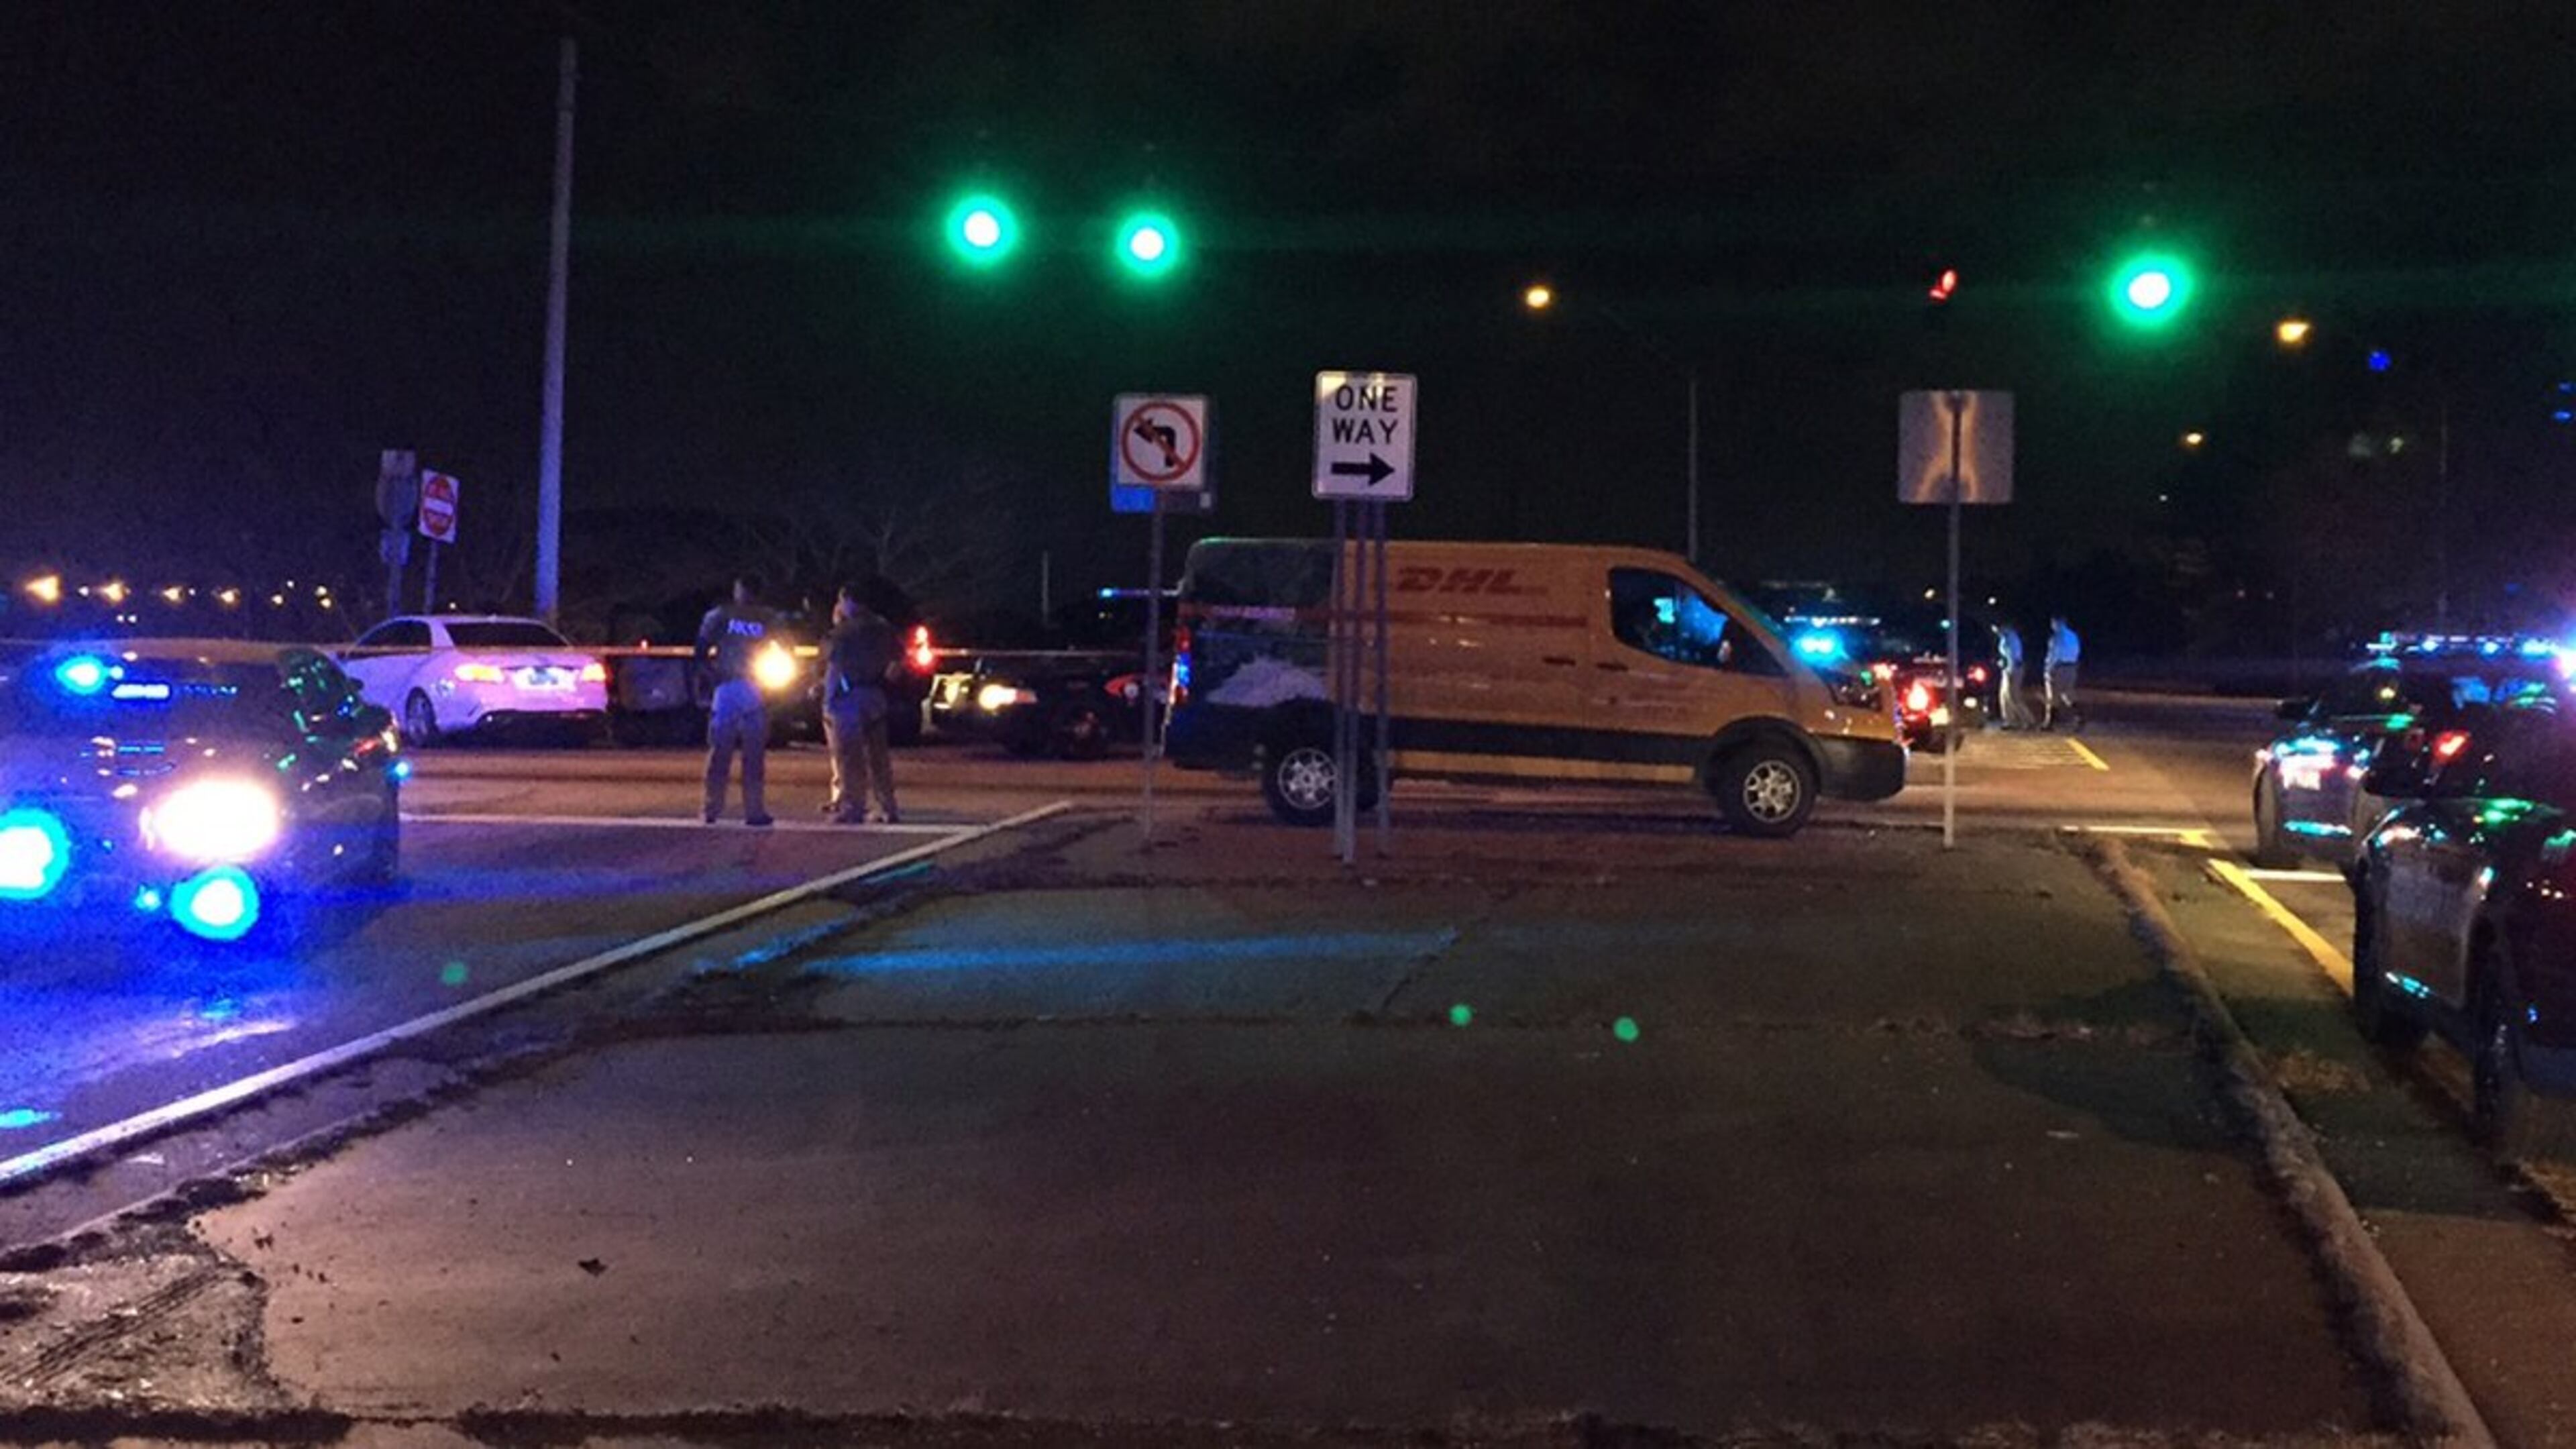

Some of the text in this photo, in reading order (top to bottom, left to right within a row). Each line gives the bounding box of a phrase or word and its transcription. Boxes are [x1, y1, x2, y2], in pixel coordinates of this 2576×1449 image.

[1335, 384, 1398, 413] ONE
[1332, 418, 1398, 445] WAY
[1397, 567, 1522, 594] DHL
